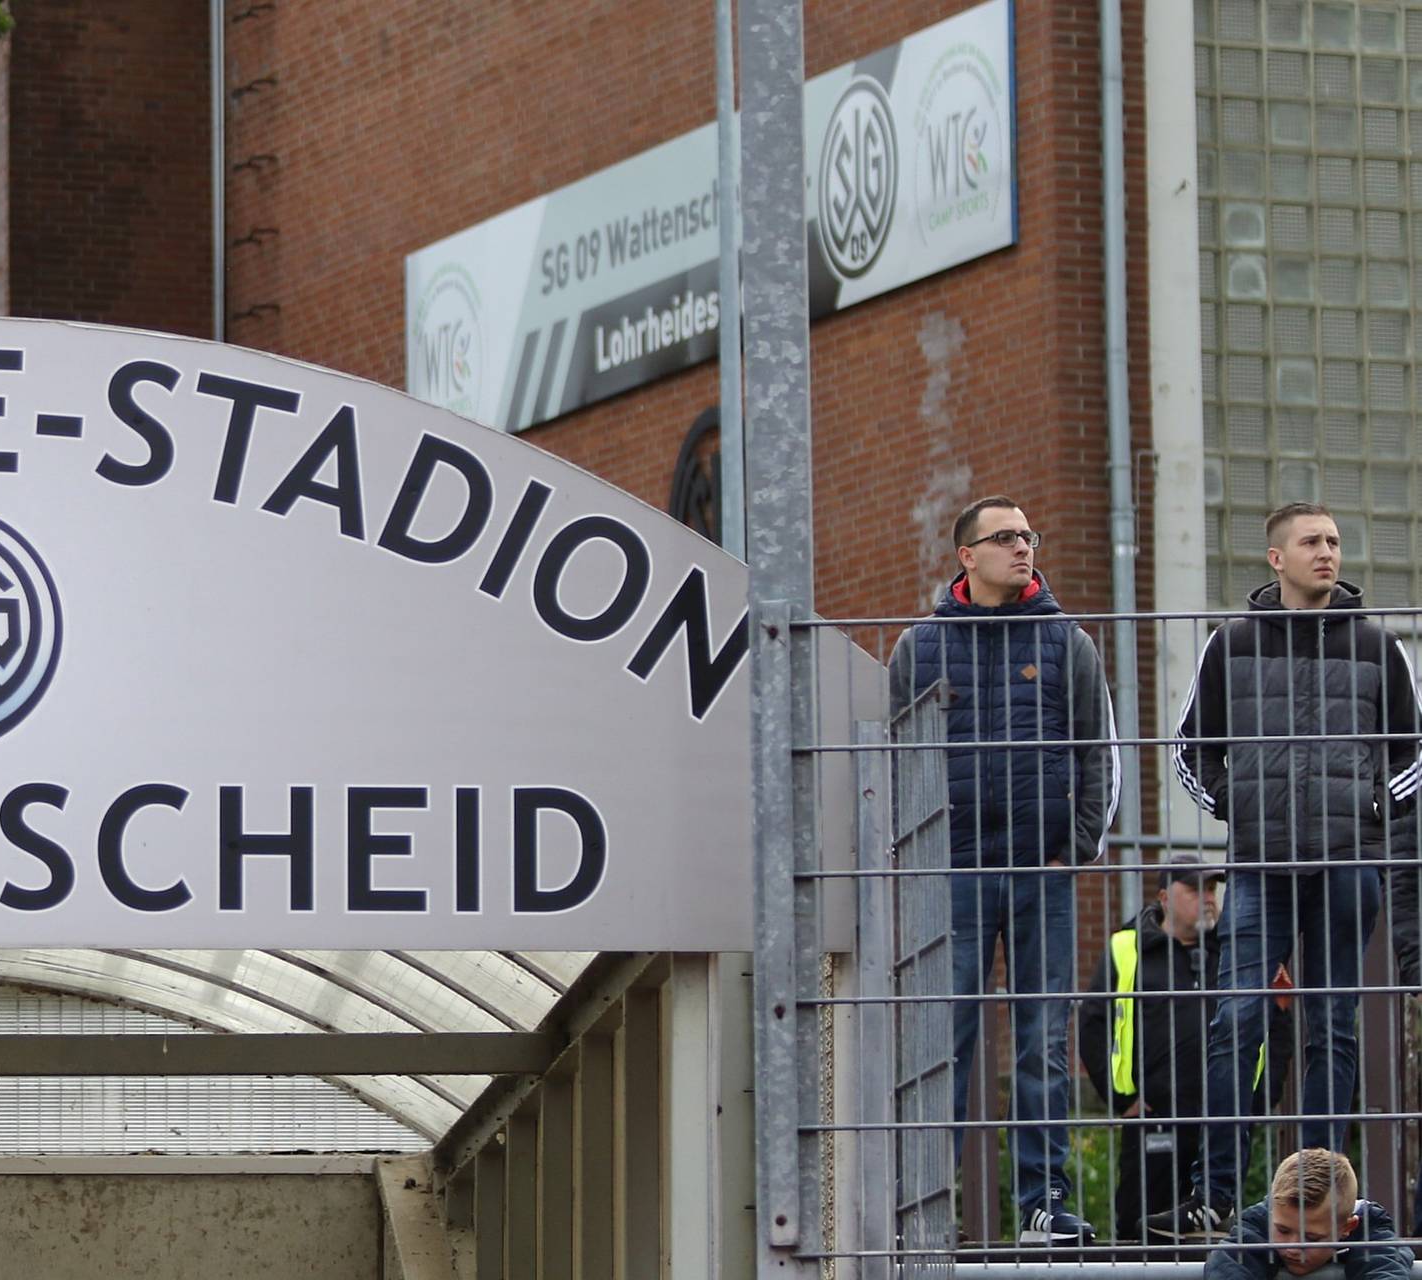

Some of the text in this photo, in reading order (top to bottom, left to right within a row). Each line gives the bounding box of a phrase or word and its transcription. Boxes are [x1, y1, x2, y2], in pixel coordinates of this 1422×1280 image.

[541, 243, 569, 295] SG
[576, 229, 601, 282] 09
[850, 233, 868, 261] 09
[595, 290, 720, 373] Lohrheides
